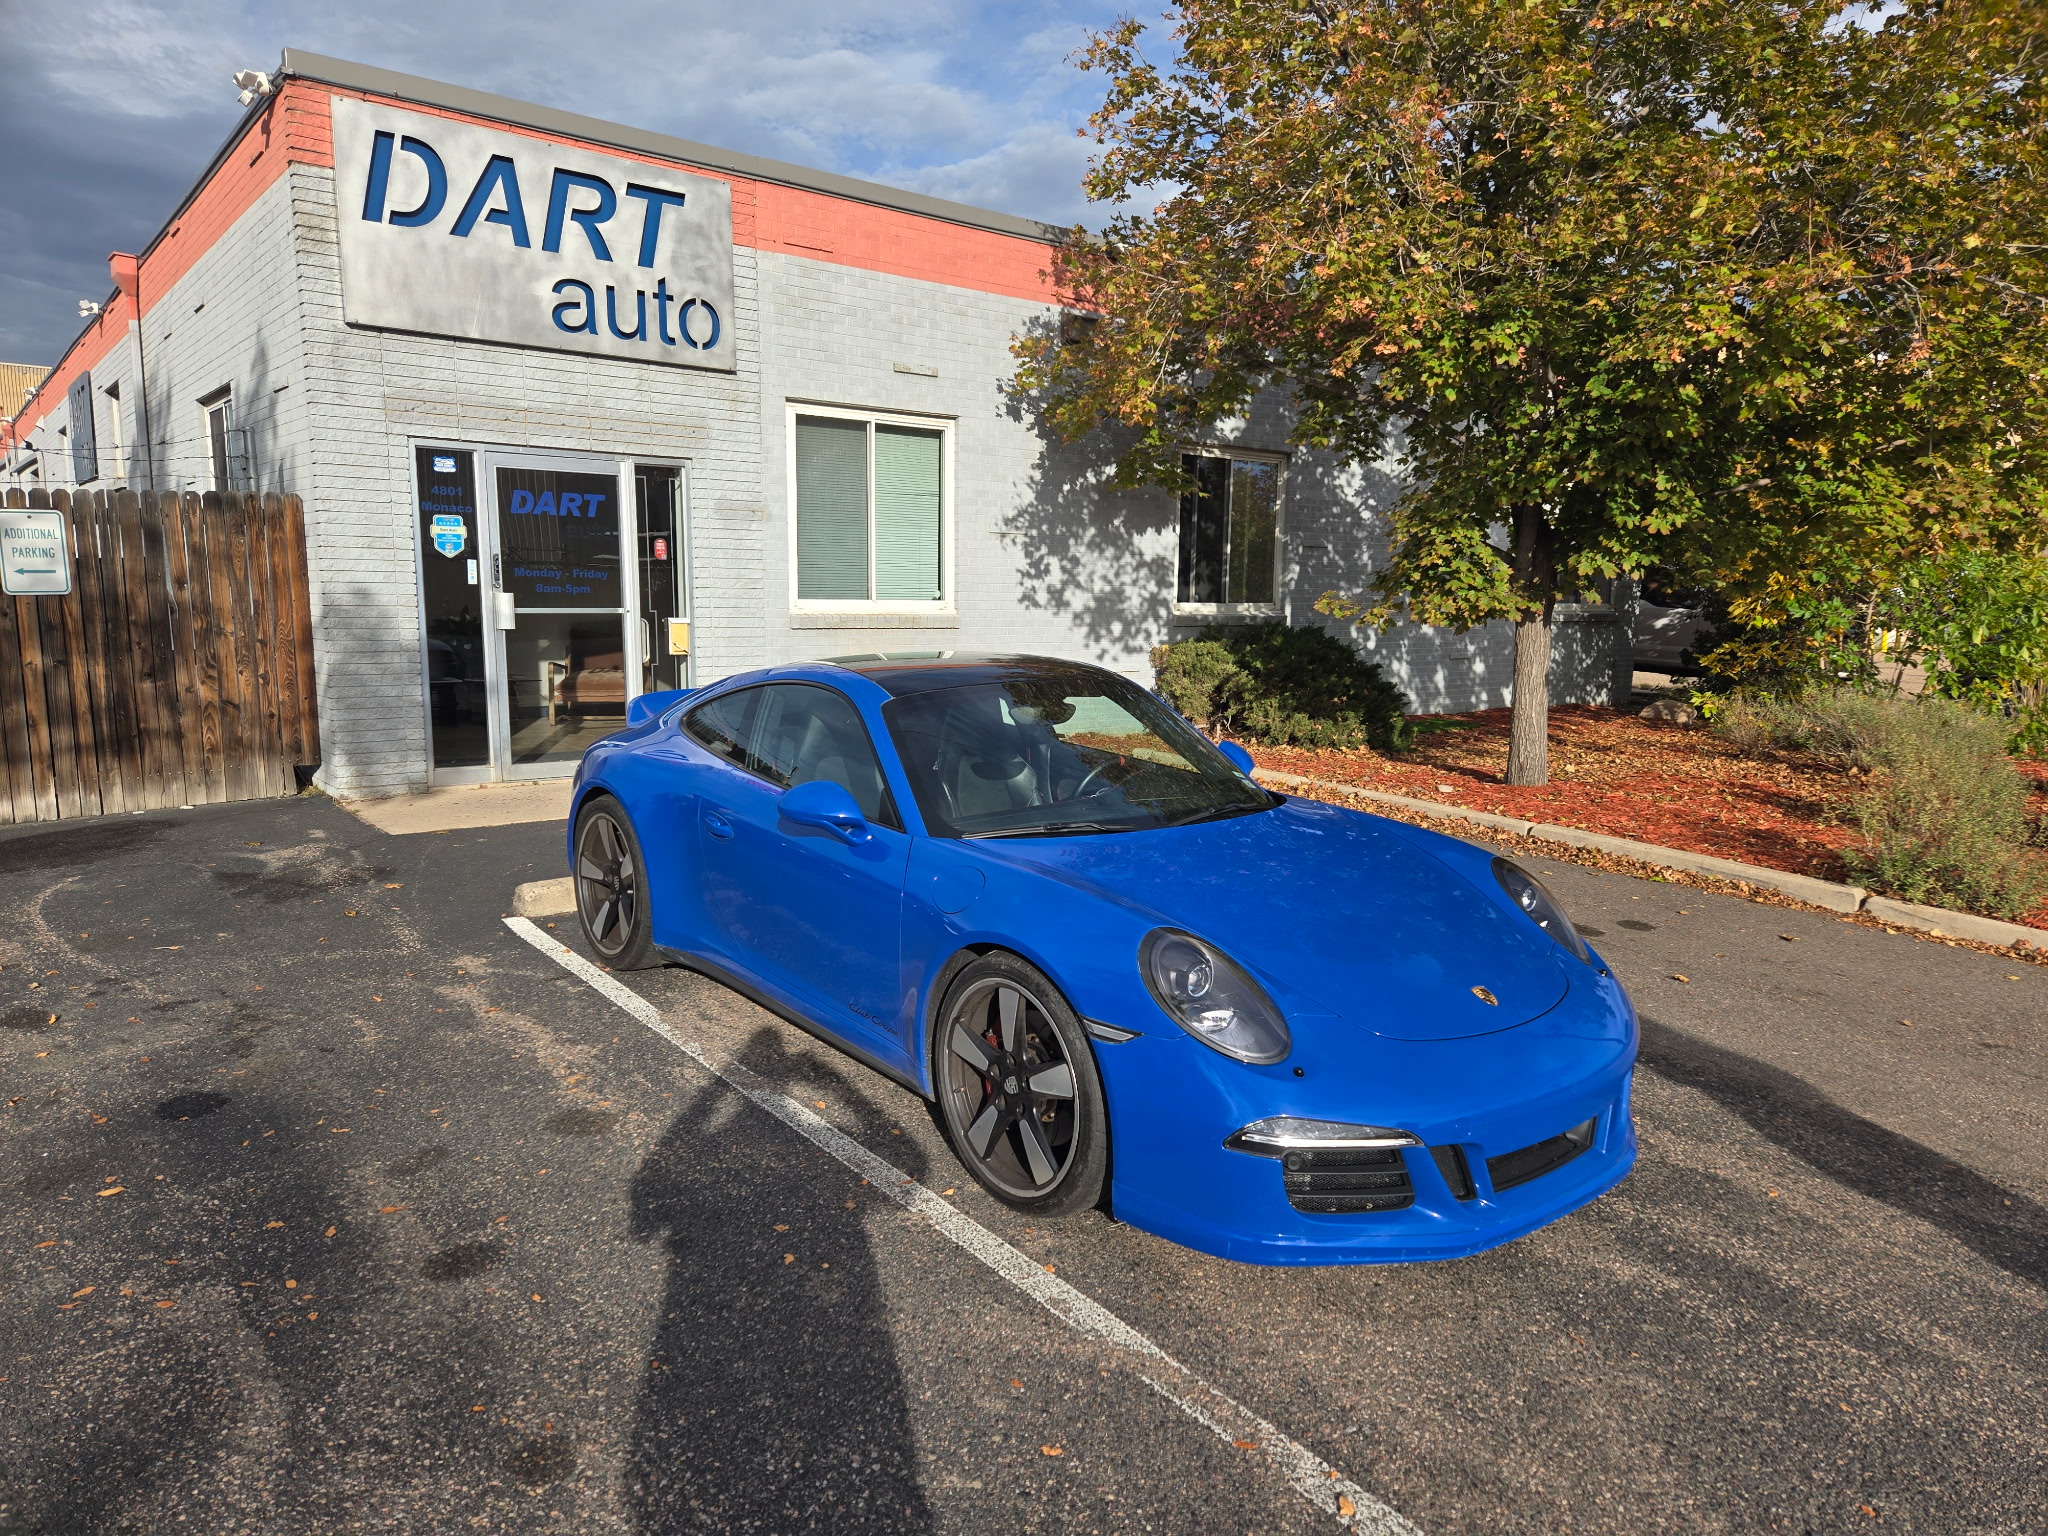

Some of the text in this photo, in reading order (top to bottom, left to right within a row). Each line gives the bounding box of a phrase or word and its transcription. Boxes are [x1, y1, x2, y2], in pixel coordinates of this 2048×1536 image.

[362, 129, 686, 268] DART
[551, 277, 721, 351] auto
[431, 485, 463, 497] 4801
[421, 500, 473, 513] Monaco
[510, 489, 606, 518] DART
[4, 527, 59, 540] ADDITIONAL
[11, 547, 55, 559] PARKING
[514, 567, 563, 579] Monday
[572, 568, 609, 581] Friday
[535, 583, 591, 595] 8am-5pm
